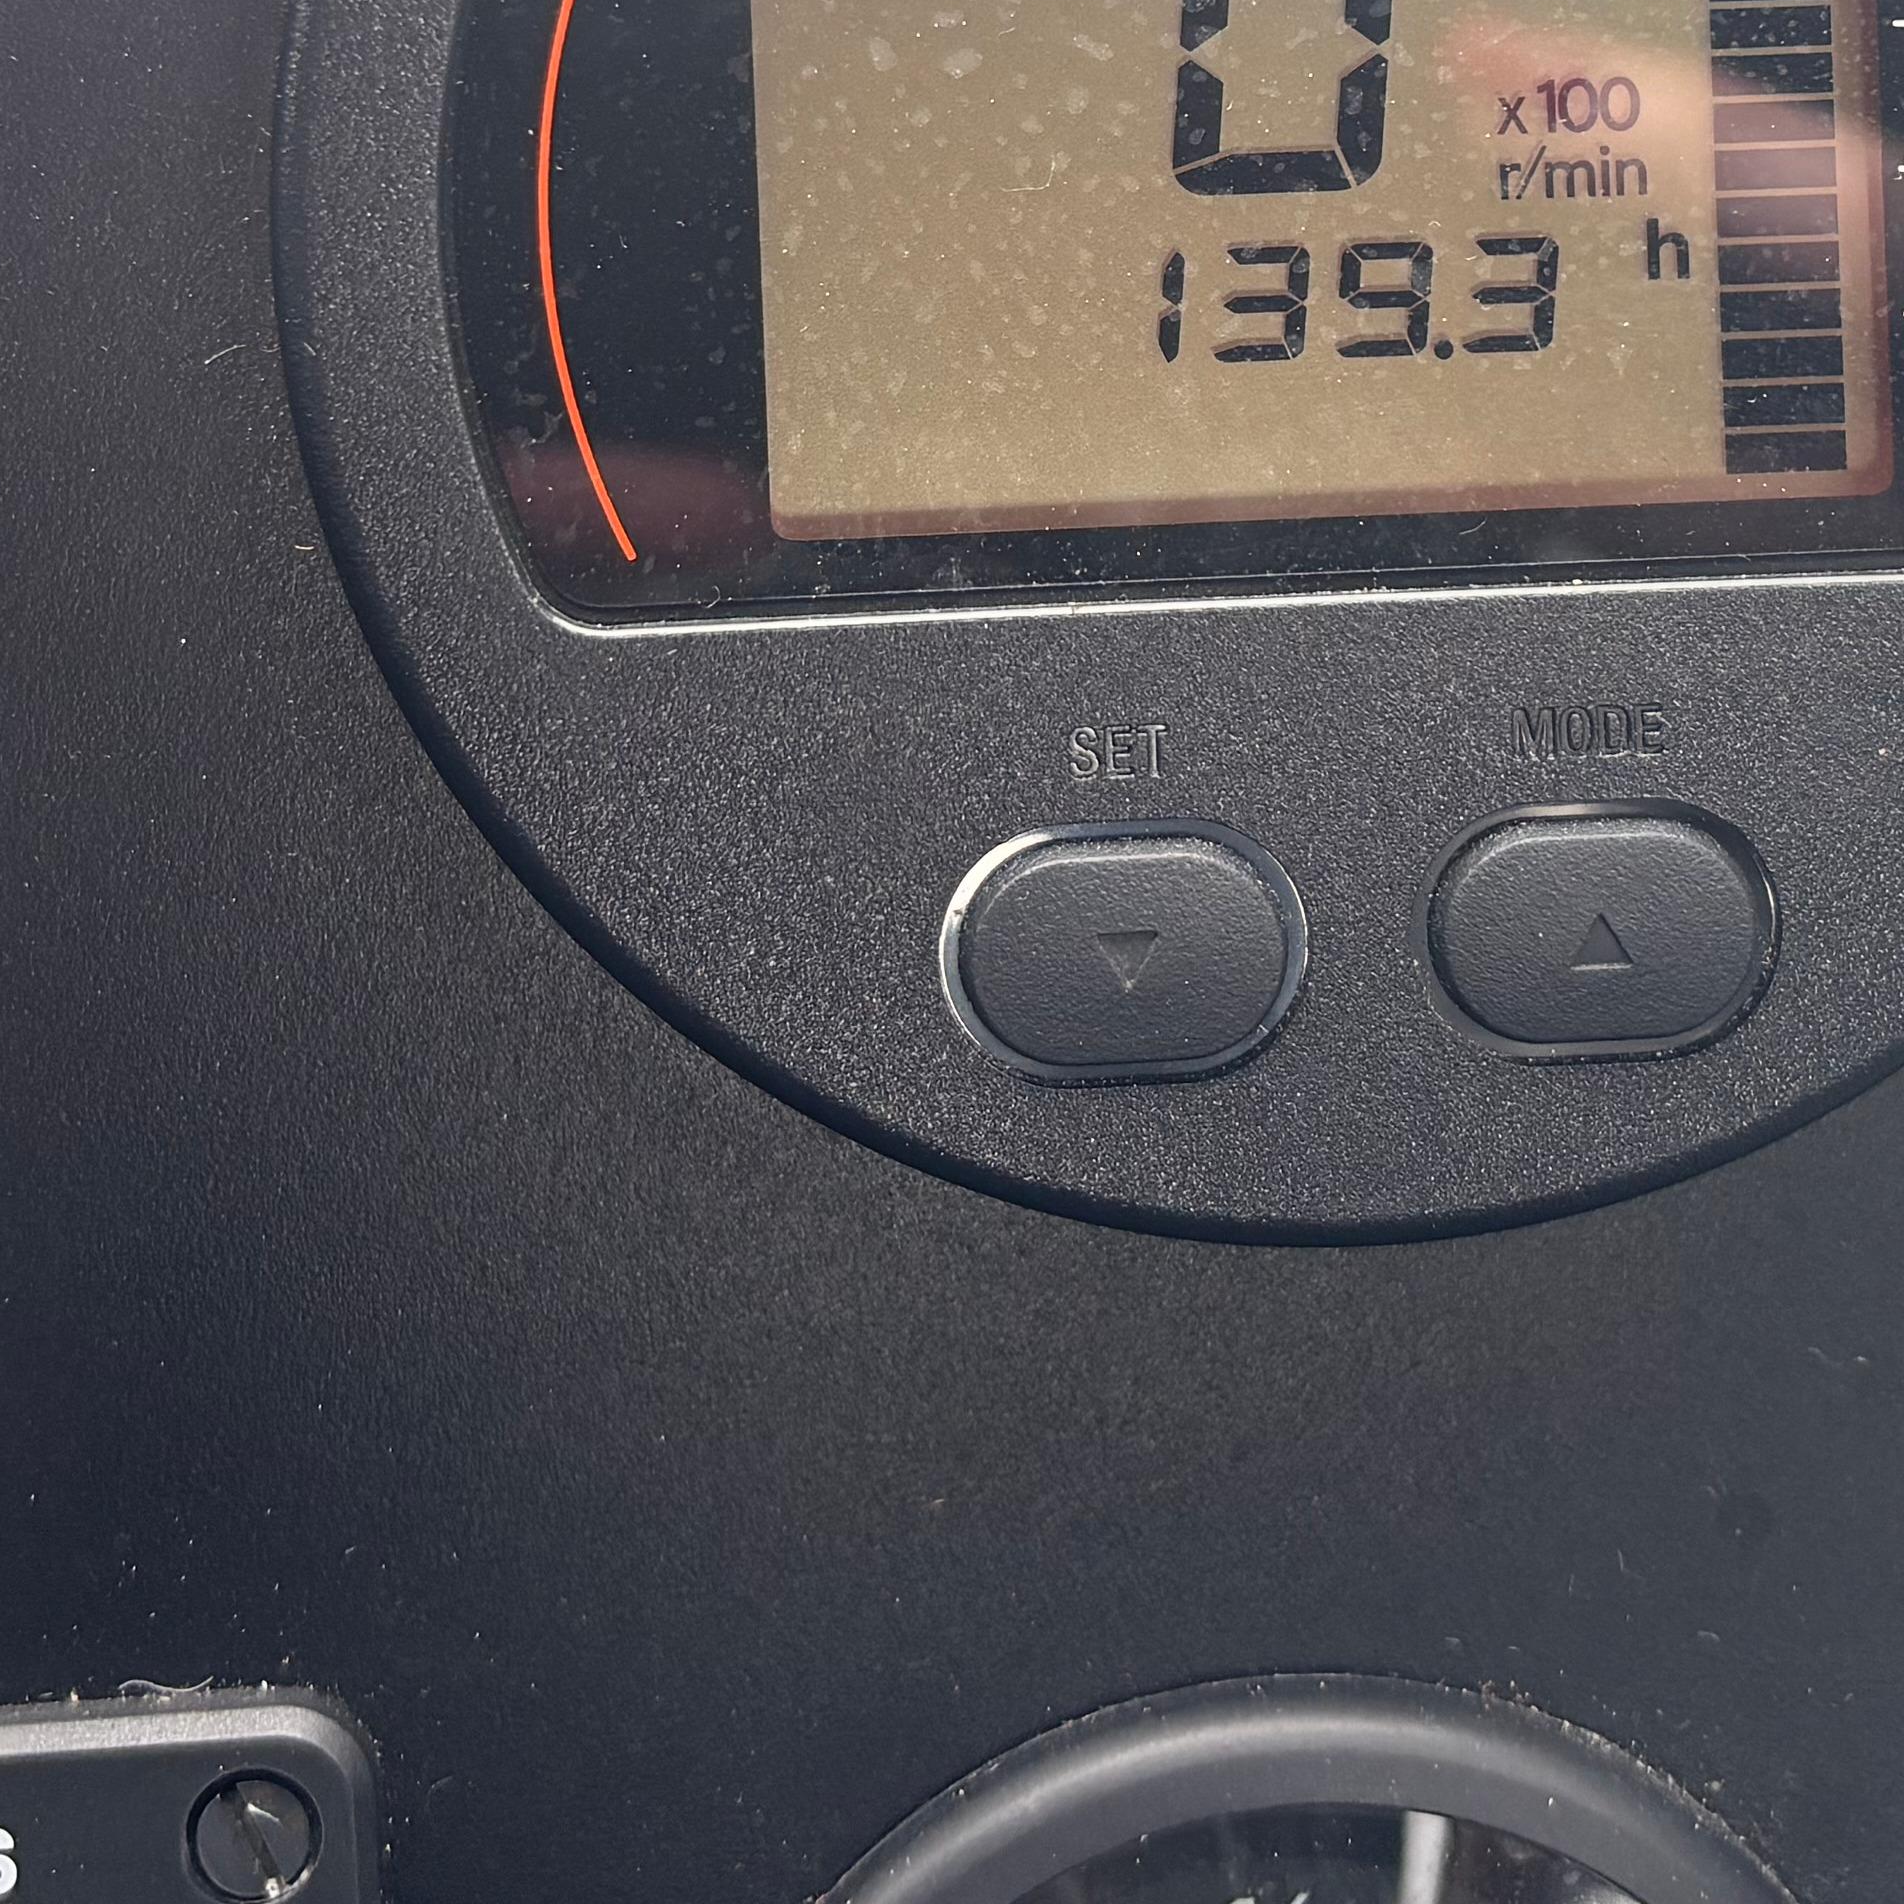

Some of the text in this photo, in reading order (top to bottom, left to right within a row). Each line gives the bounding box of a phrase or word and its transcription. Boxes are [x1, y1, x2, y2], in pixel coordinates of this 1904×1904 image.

[1497, 76, 1642, 135] x100
[1498, 145, 1649, 201] r/min
[1157, 218, 1691, 364] 139.3 h
[1071, 726, 1169, 781] SET
[1513, 703, 1669, 761] MODE
